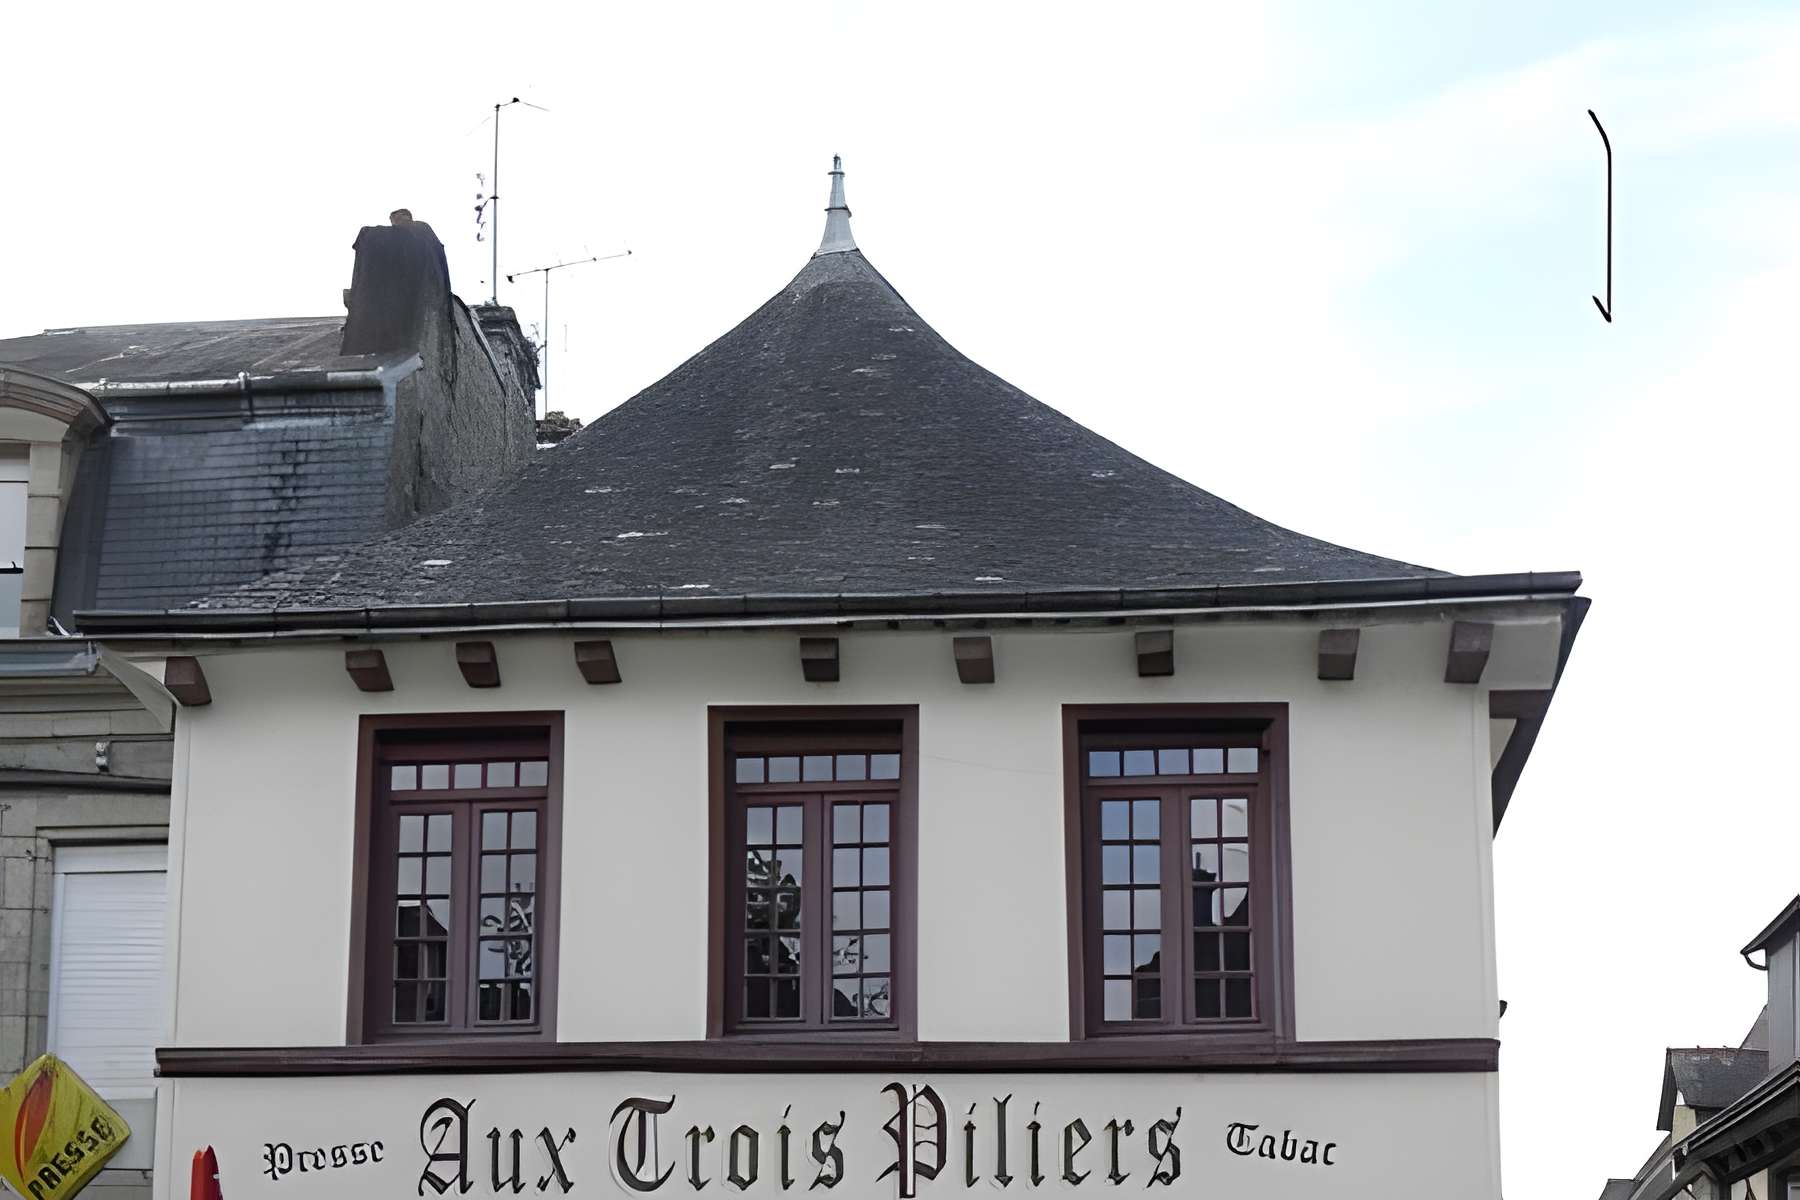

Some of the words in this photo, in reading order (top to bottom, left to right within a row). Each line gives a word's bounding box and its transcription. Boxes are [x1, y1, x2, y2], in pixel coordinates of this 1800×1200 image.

[263, 1140, 385, 1180] Presse
[417, 1097, 577, 1197] Aux
[608, 1094, 847, 1194] Trois
[875, 1081, 1185, 1199] Piliers
[1226, 1122, 1337, 1166] Tabac
